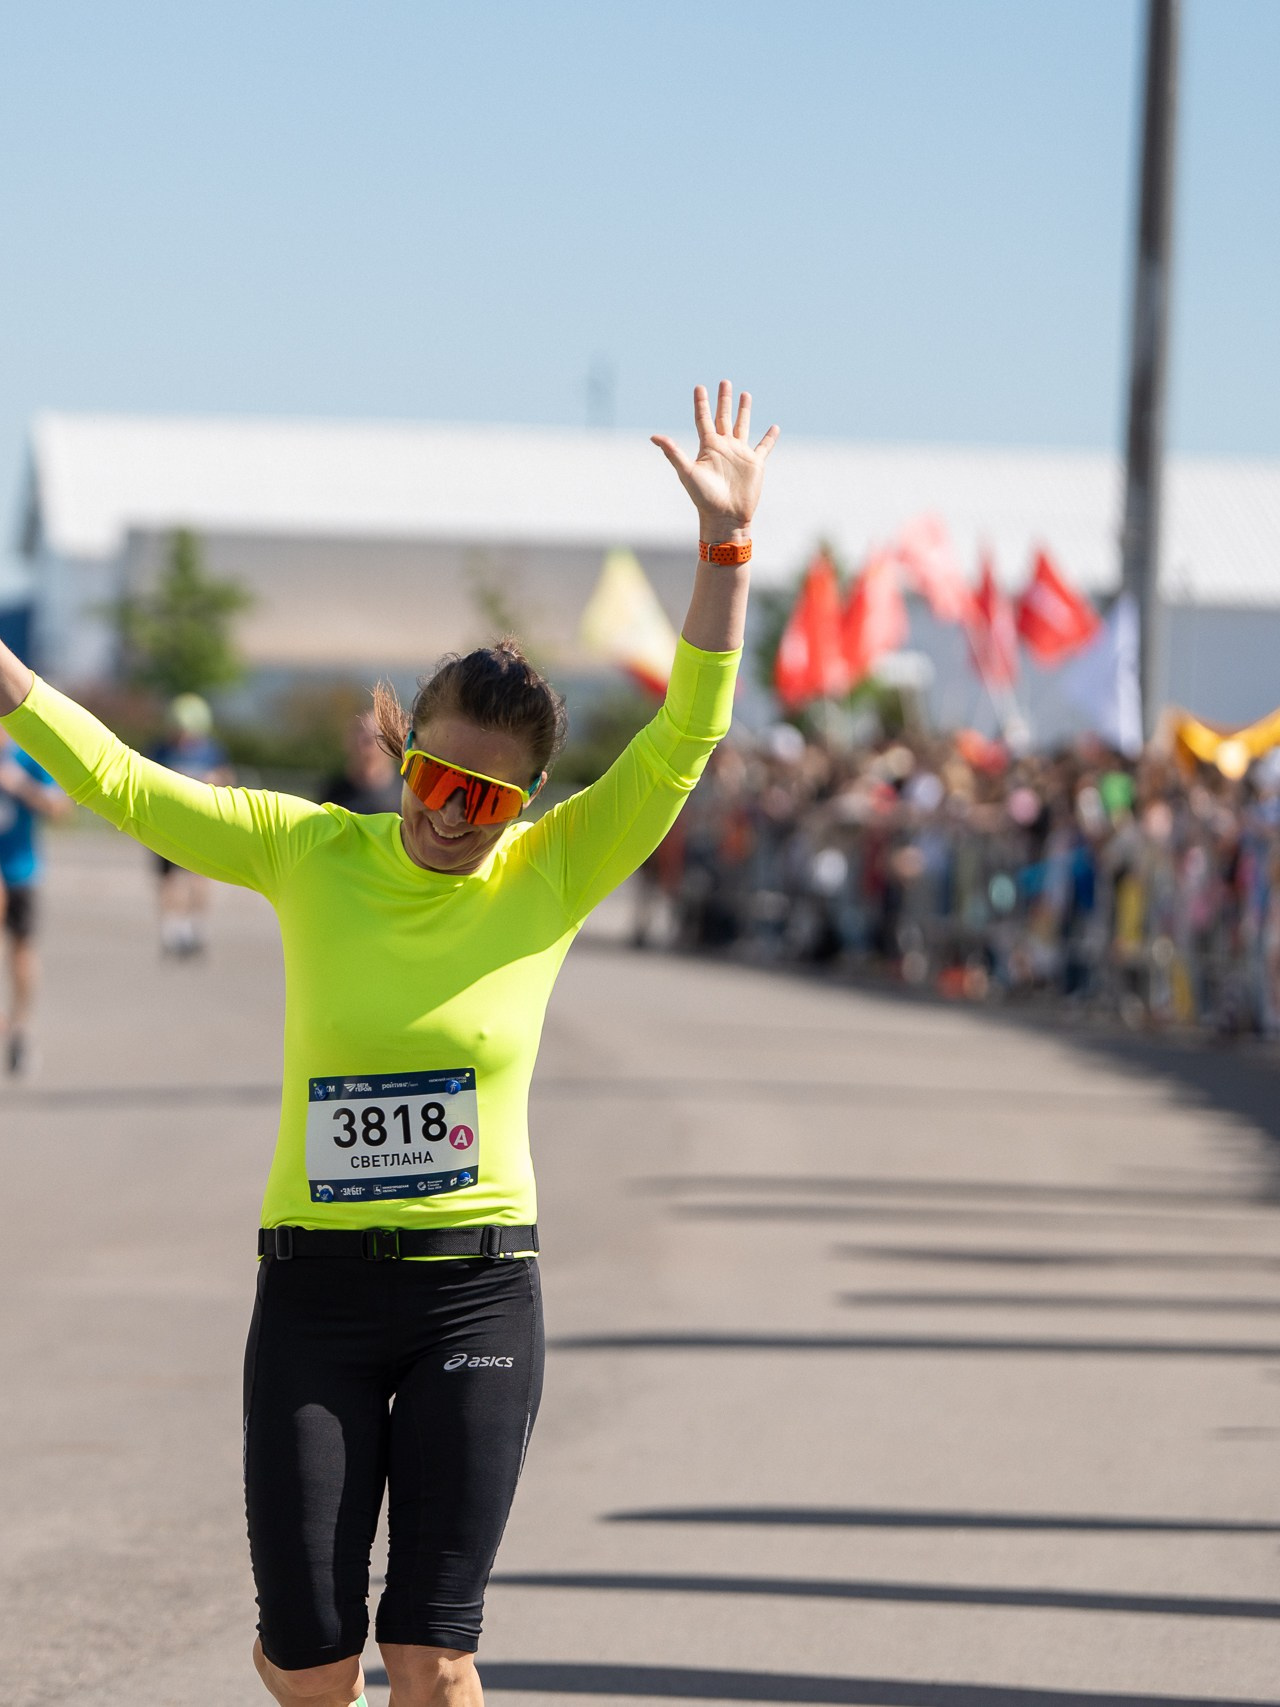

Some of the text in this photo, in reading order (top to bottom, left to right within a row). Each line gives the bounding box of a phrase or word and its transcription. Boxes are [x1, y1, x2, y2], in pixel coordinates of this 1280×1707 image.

[332, 1101, 448, 1149] 3818
[350, 1150, 434, 1169] СВЕТЛАНА
[467, 1356, 514, 1368] asics
